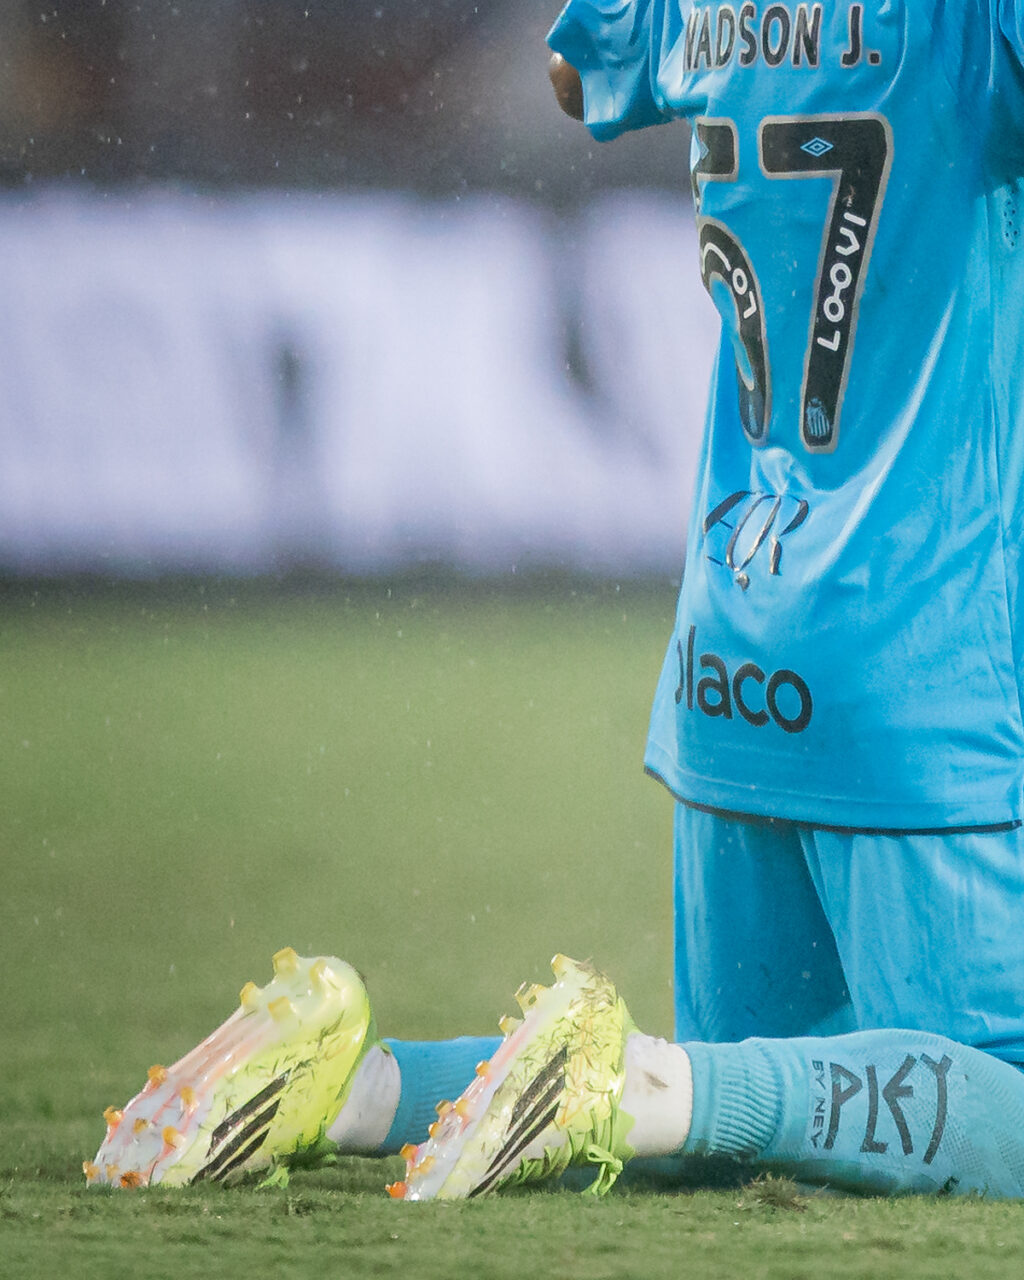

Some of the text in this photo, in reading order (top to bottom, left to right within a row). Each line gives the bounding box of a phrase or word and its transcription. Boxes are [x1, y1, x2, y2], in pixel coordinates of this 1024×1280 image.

[841, 4, 880, 66] J.
[817, 212, 866, 351] LOOVI
[810, 1096, 827, 1149] NEY
